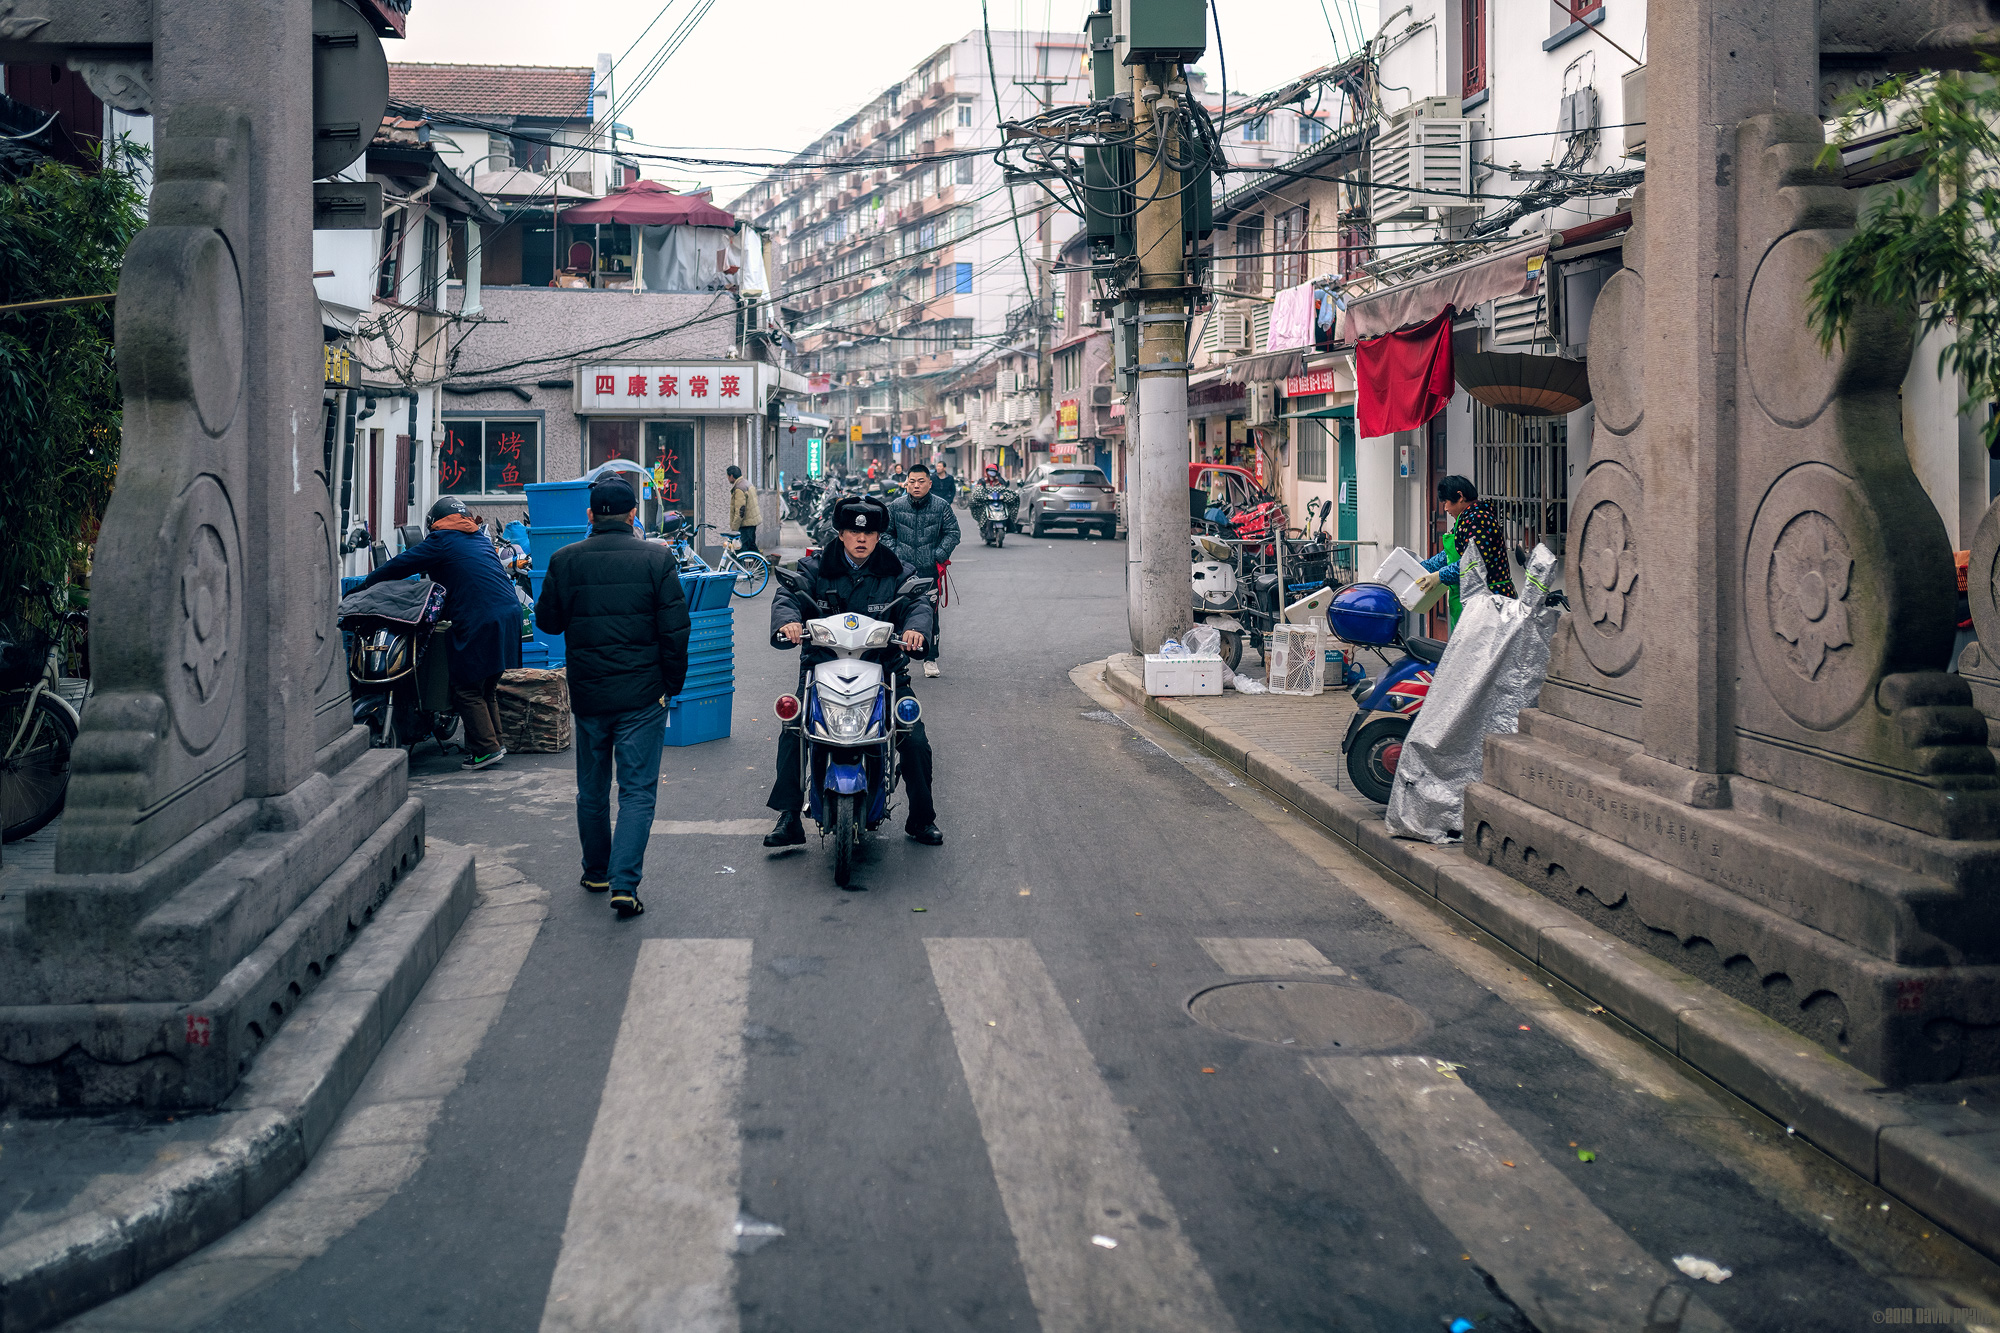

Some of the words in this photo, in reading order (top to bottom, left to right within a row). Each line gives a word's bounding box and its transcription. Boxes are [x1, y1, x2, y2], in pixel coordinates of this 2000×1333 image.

[595, 374, 740, 398] 四康家常菜
[497, 431, 525, 488] 烤鱼
[654, 448, 681, 503] 欢迎
